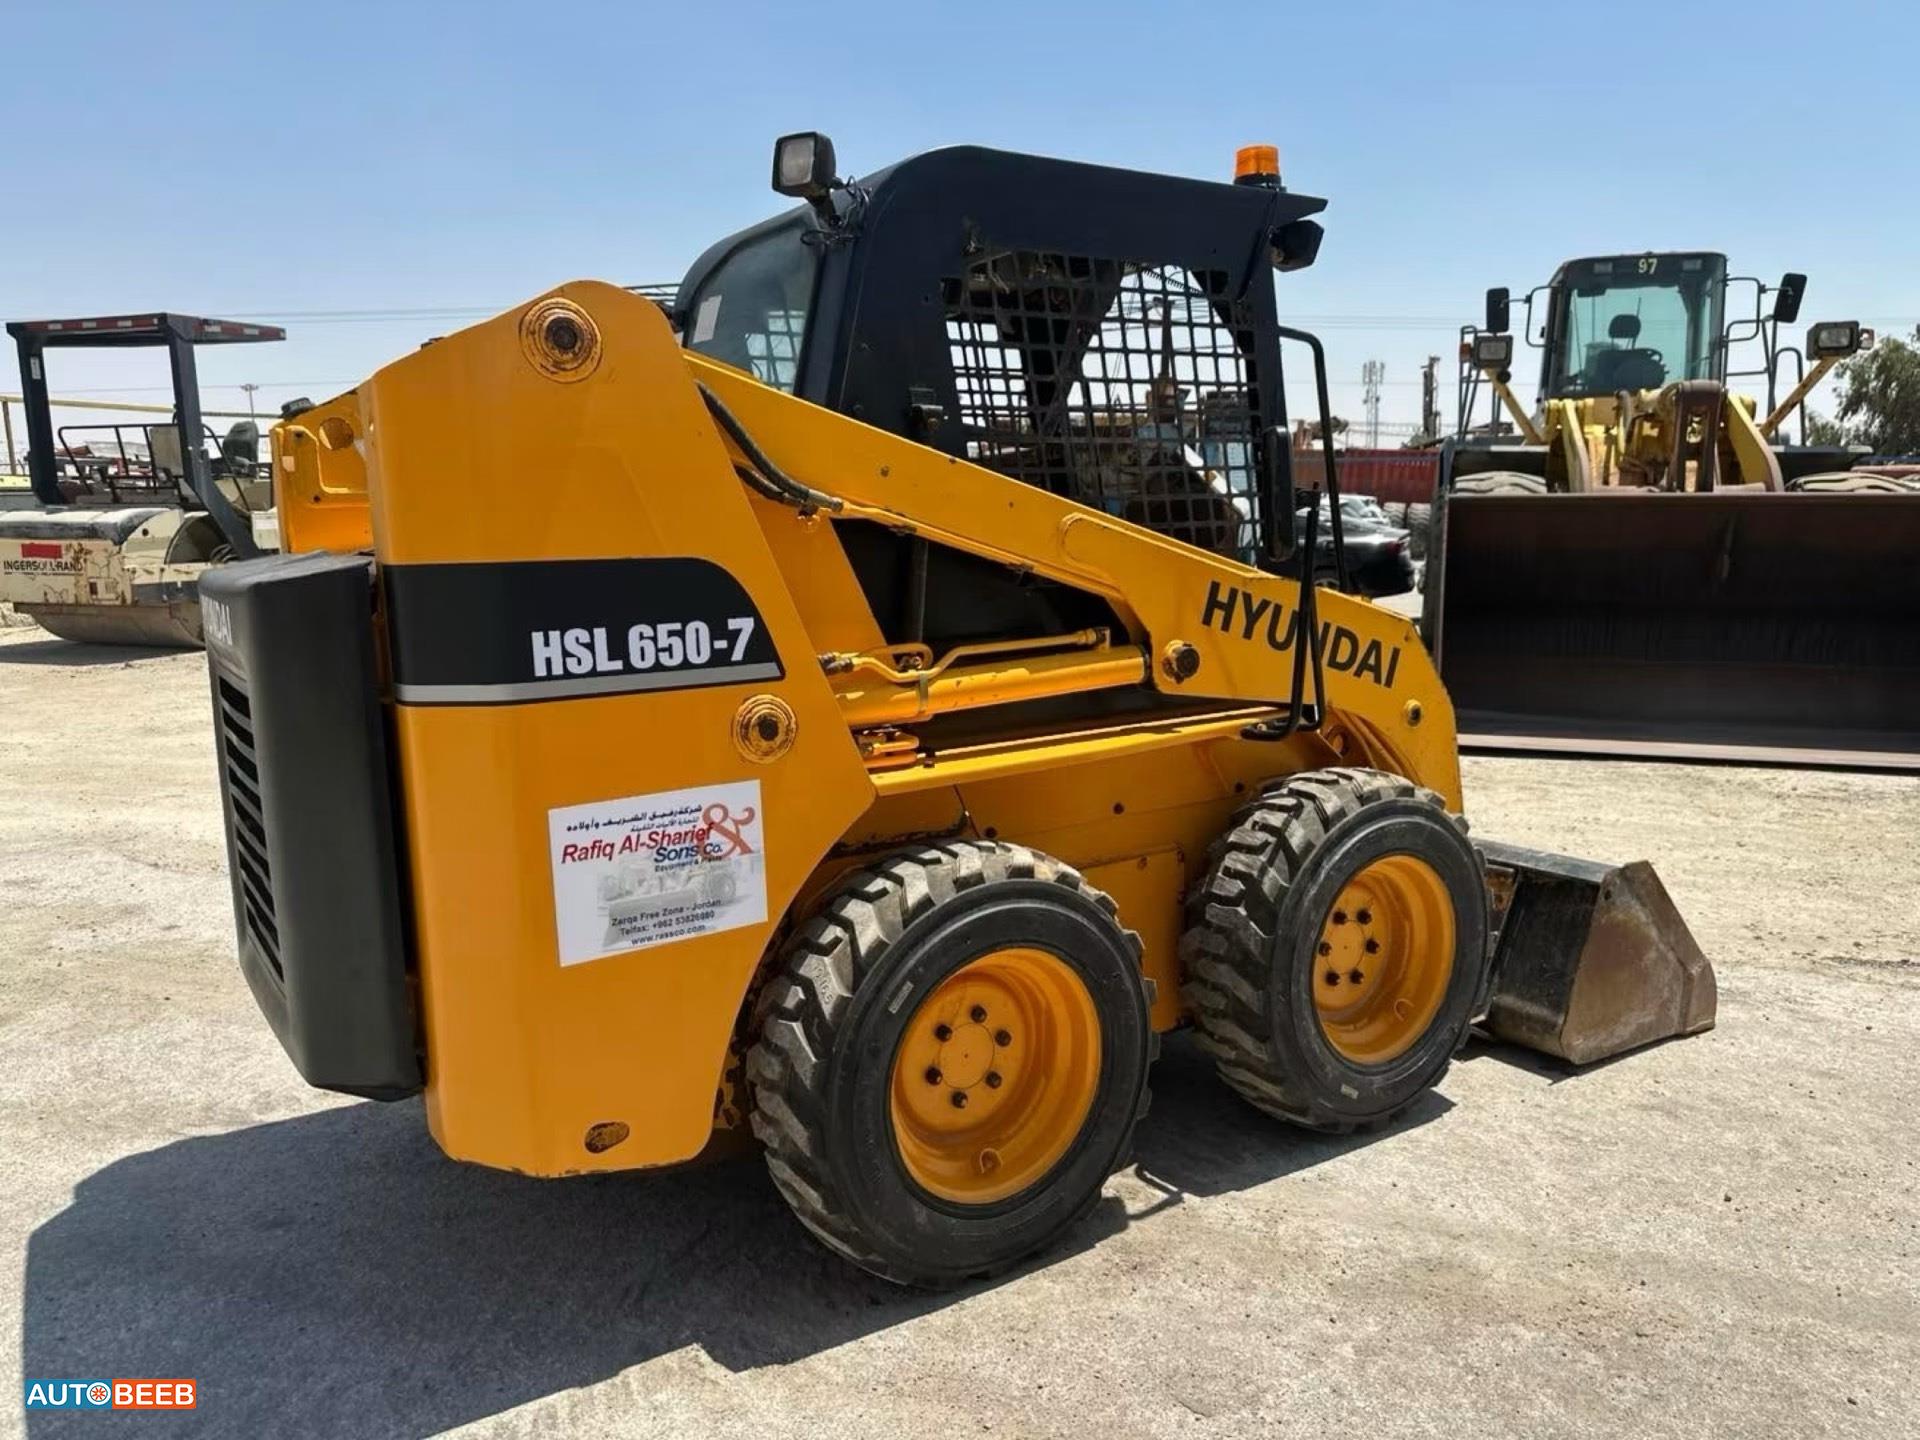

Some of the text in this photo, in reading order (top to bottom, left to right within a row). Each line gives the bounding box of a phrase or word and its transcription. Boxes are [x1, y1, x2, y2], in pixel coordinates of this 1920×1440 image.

[1638, 258, 1658, 275] 97
[530, 617, 755, 678] HSL 650-7
[561, 803, 756, 864] Rafiq Al-Sharief &
[654, 844, 699, 864] Sons
[703, 843, 724, 855] Co.
[611, 914, 638, 927] Zarqa
[640, 911, 661, 922] Free
[662, 906, 685, 917] Zone
[691, 899, 723, 912] Jordan
